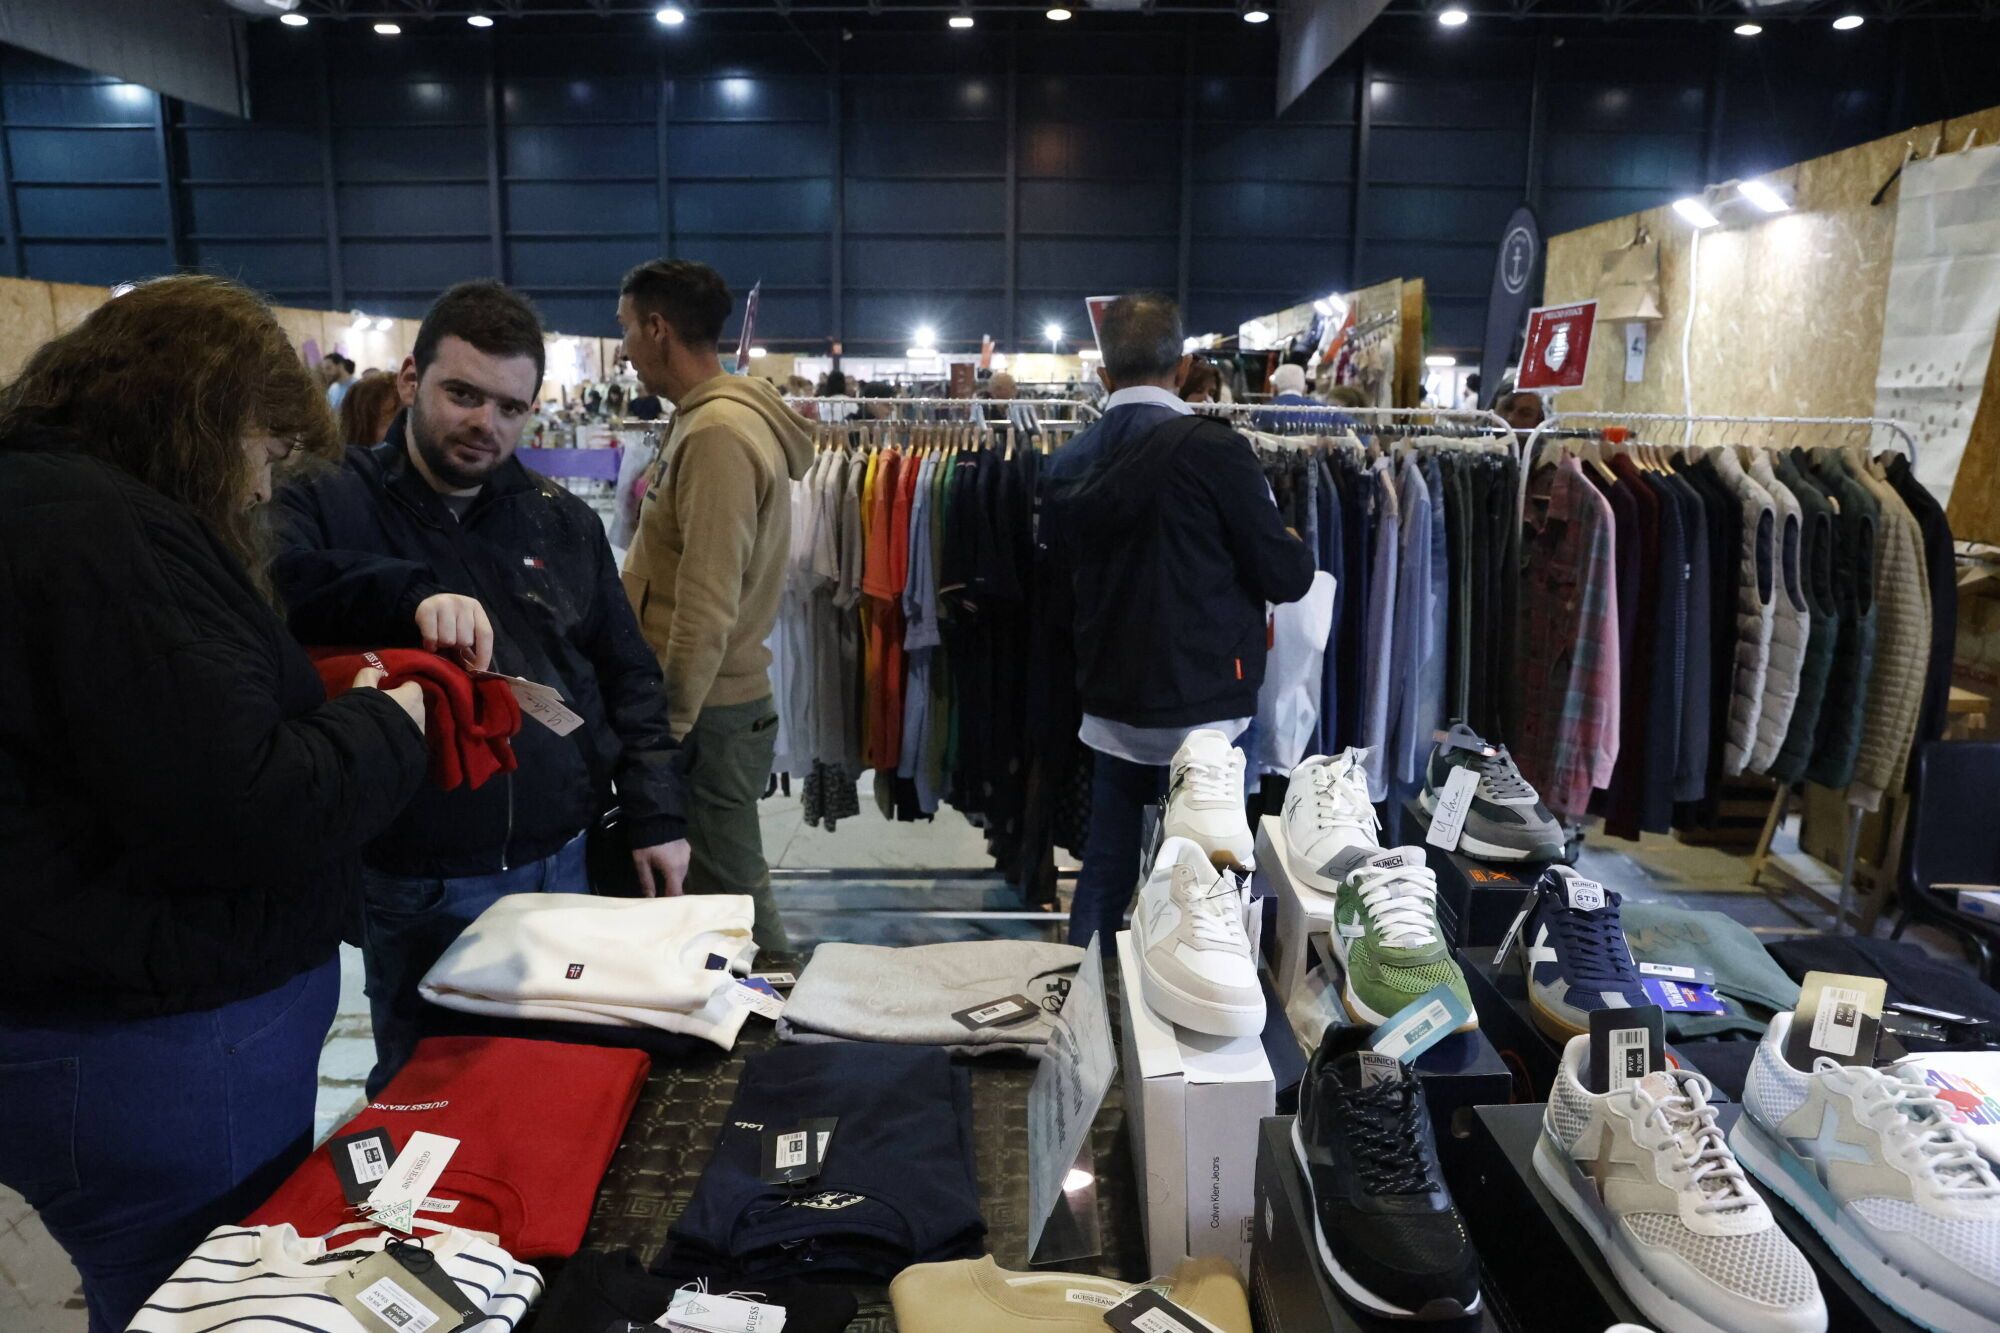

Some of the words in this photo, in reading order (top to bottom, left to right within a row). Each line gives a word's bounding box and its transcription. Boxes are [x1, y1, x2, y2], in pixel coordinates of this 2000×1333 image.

[1372, 857, 1404, 869] MUNICH
[1577, 894, 1598, 903] STB
[1363, 1056, 1397, 1067] MUNICH
[1210, 1156, 1220, 1181] Jeans
[1210, 1182, 1220, 1202] Klein
[378, 1204, 409, 1220] GUESS
[1210, 1203, 1220, 1229] Calvin
[745, 1305, 760, 1333] GUESS
